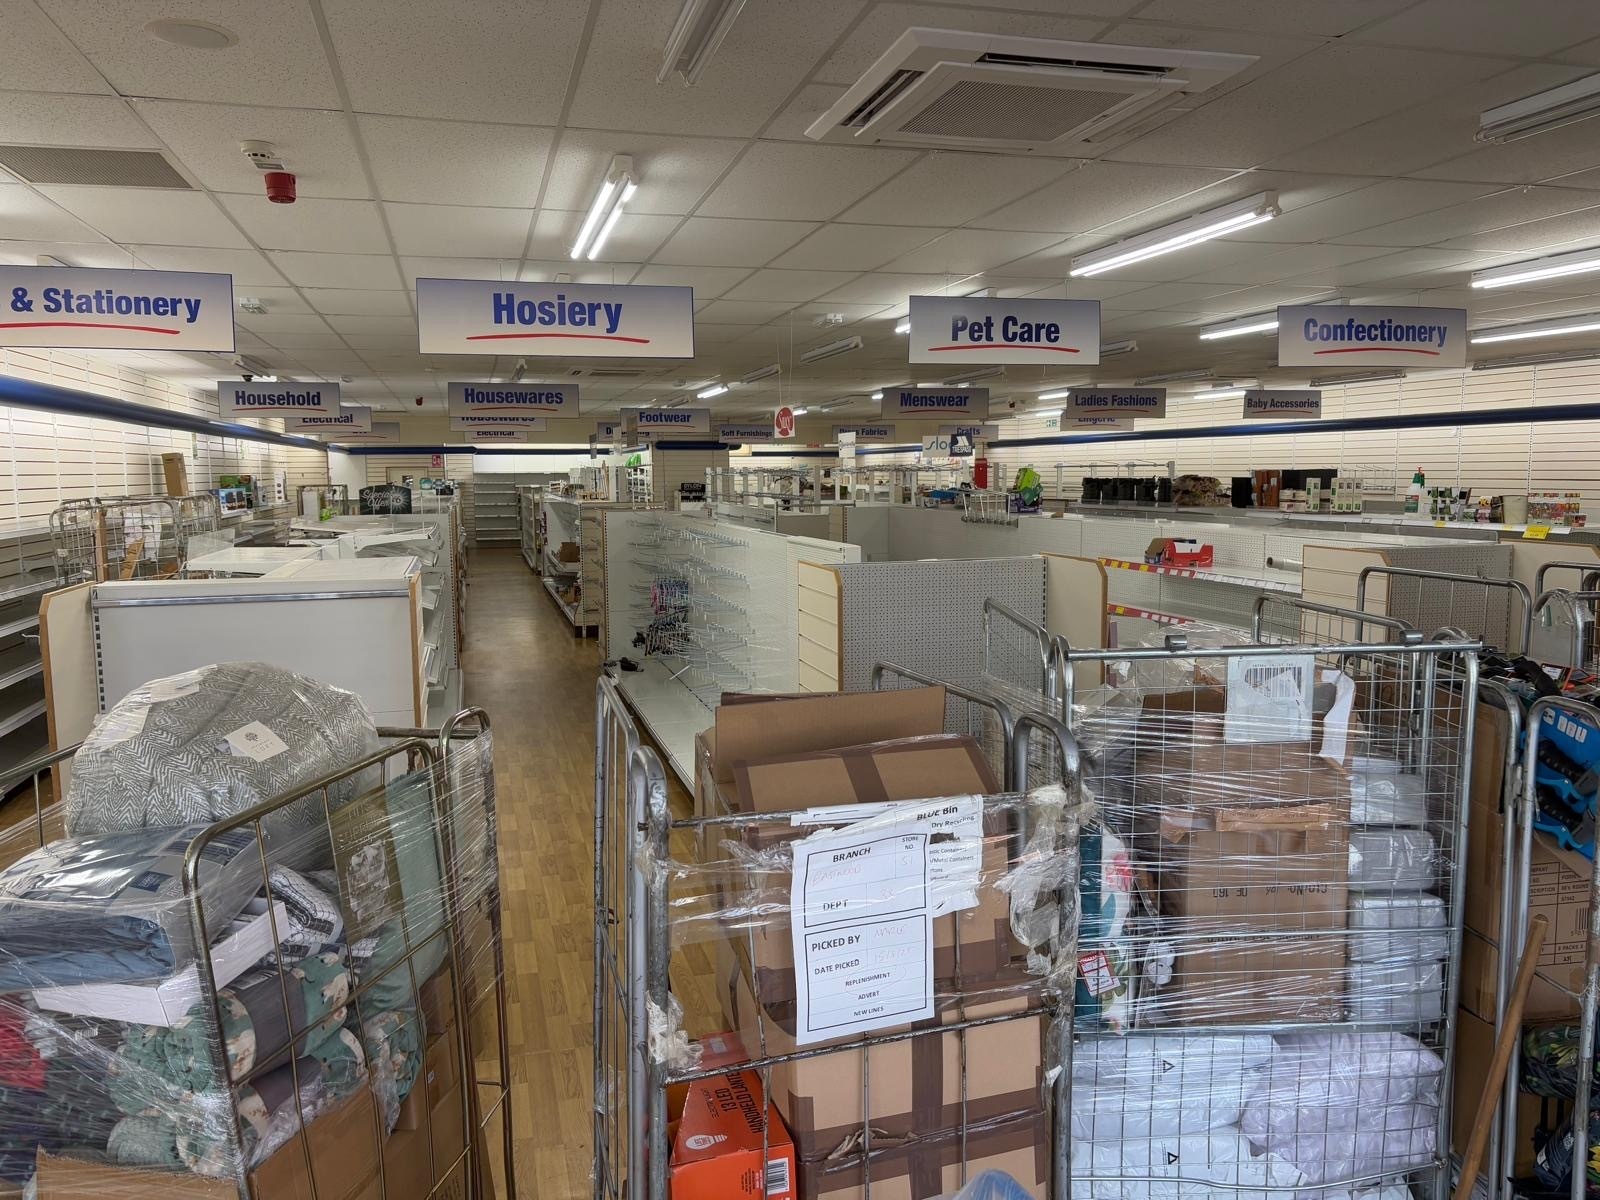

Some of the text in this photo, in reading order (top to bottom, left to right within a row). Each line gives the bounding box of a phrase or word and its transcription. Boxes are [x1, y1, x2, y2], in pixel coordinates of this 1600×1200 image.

[10, 286, 202, 323] & Stationery
[492, 292, 623, 333] Hosiery
[951, 314, 1060, 343] Pet Care
[1303, 318, 1448, 347] Confectionery
[234, 390, 322, 407] Household
[464, 388, 564, 405] Housewares
[900, 393, 970, 407] Menswear
[1075, 394, 1158, 407] Ladies Fashions
[1247, 397, 1320, 410] Baby Accessories
[639, 411, 692, 423] Footwear
[861, 428, 888, 436] Fabrics
[956, 427, 981, 436] Crafts
[916, 806, 958, 820] BLUE Bin
[931, 815, 975, 829] Dry Recycling
[902, 835, 919, 843] STORE
[832, 847, 872, 863] BRANCH
[823, 899, 849, 911] DEPT
[811, 934, 861, 952] PICKED BY
[814, 958, 860, 975] DATE PICKED
[845, 972, 891, 987] REPLENISHMENT
[858, 990, 880, 1001] ADVERT
[853, 1005, 885, 1017] NEW LINES
[721, 1102, 738, 1112] 13
[735, 1094, 765, 1133] HANDHELD
